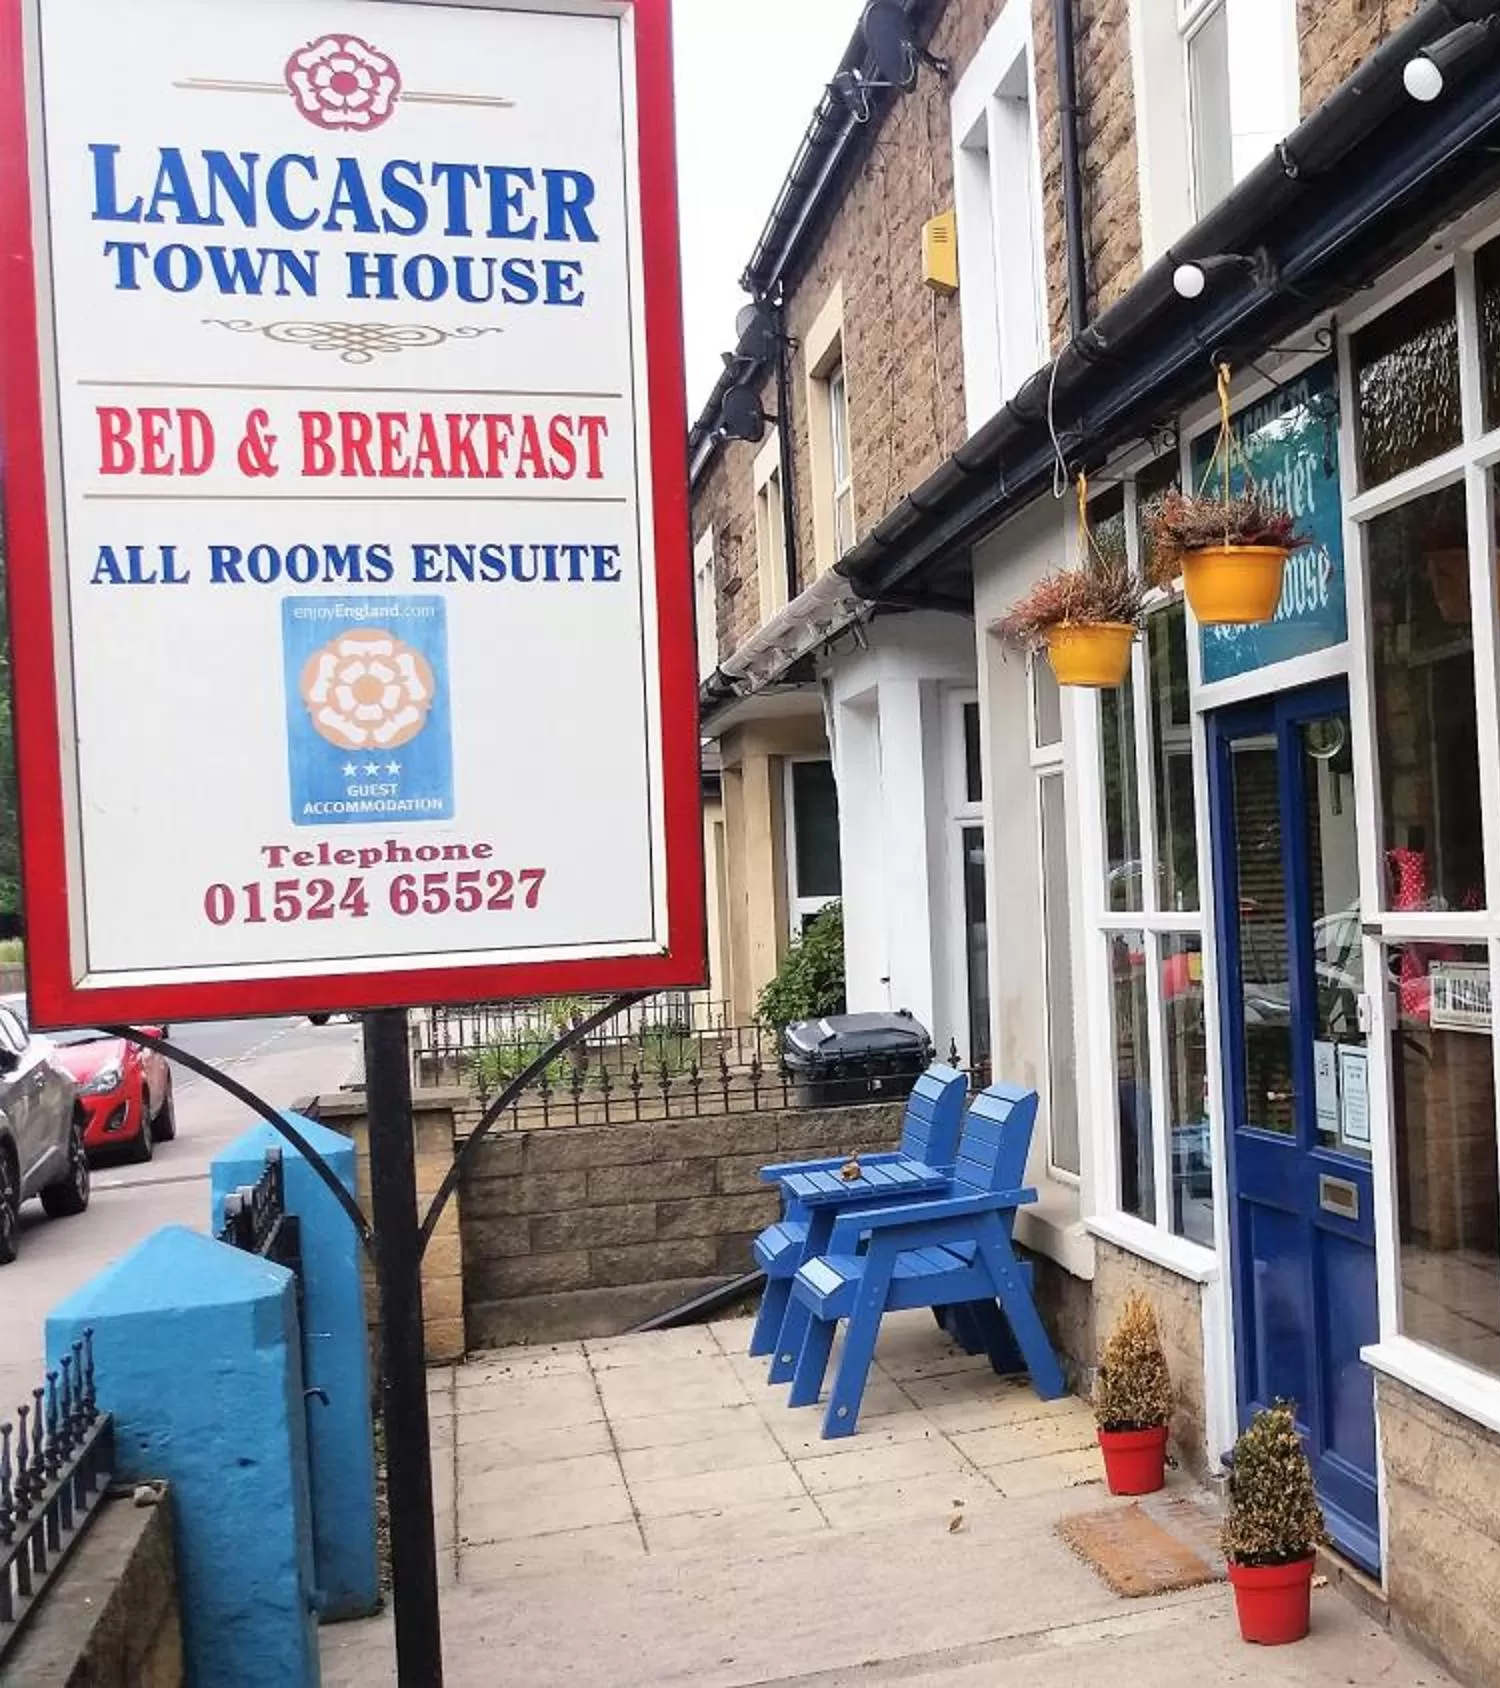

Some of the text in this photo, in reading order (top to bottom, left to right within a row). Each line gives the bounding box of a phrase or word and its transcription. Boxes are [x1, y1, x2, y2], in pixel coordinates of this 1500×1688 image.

[89, 143, 599, 243] LANCASTER
[104, 240, 584, 307] TOWN HOUSE
[95, 406, 608, 480] BED & BREAKFAST
[90, 543, 622, 585] ALL ROOMS ENSUITE
[1273, 545, 1331, 622] ouse
[293, 604, 436, 621] enjoyEngland.com
[303, 800, 443, 816] ACCOMMODATION
[347, 783, 399, 797] GUEST
[262, 840, 493, 869] Telephone
[204, 868, 546, 925] 01524 65527
